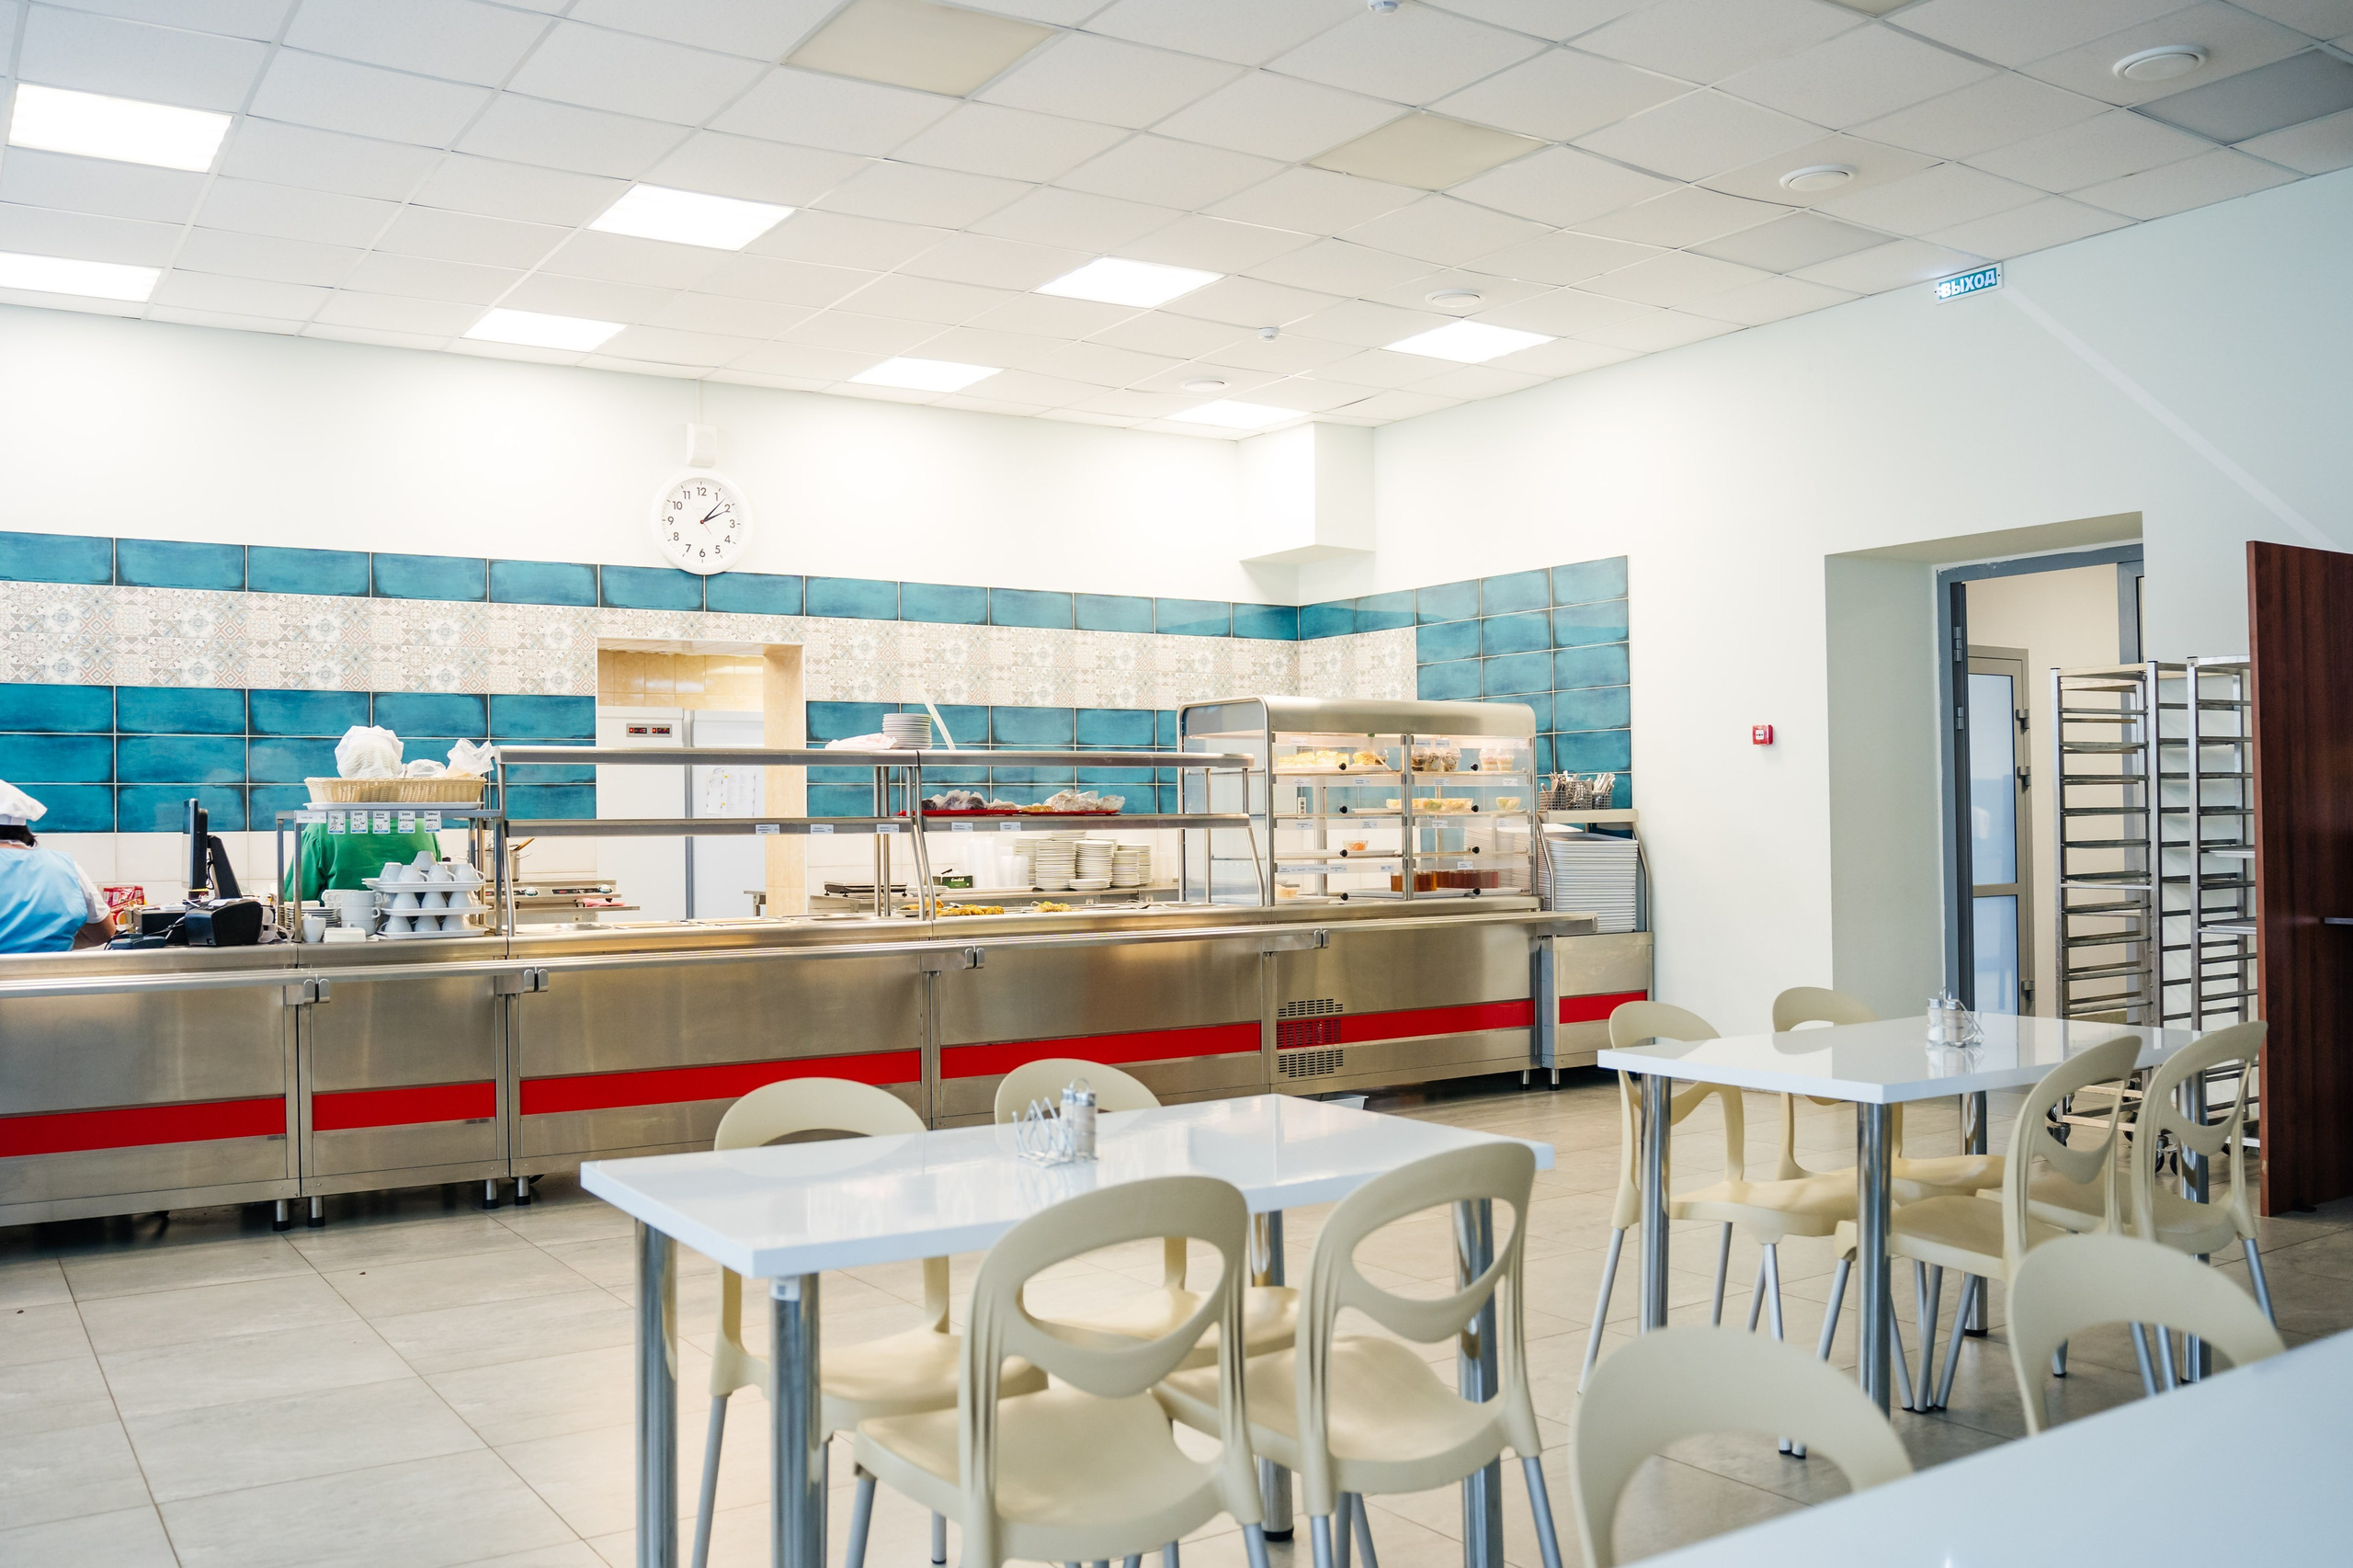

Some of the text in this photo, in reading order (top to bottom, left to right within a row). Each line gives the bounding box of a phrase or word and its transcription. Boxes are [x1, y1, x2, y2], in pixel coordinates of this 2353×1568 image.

[1940, 270, 1995, 298] ВЫХОД
[683, 491, 690, 500] 11
[697, 487, 707, 496] 12
[715, 493, 719, 501] 1
[672, 501, 683, 510] 10
[724, 504, 731, 513] 2
[667, 517, 674, 525] 9
[729, 519, 735, 528] 3
[673, 532, 679, 541] 8
[724, 535, 731, 543] 4
[685, 544, 691, 552] 7
[714, 545, 721, 554] 5
[699, 549, 706, 557] 6
